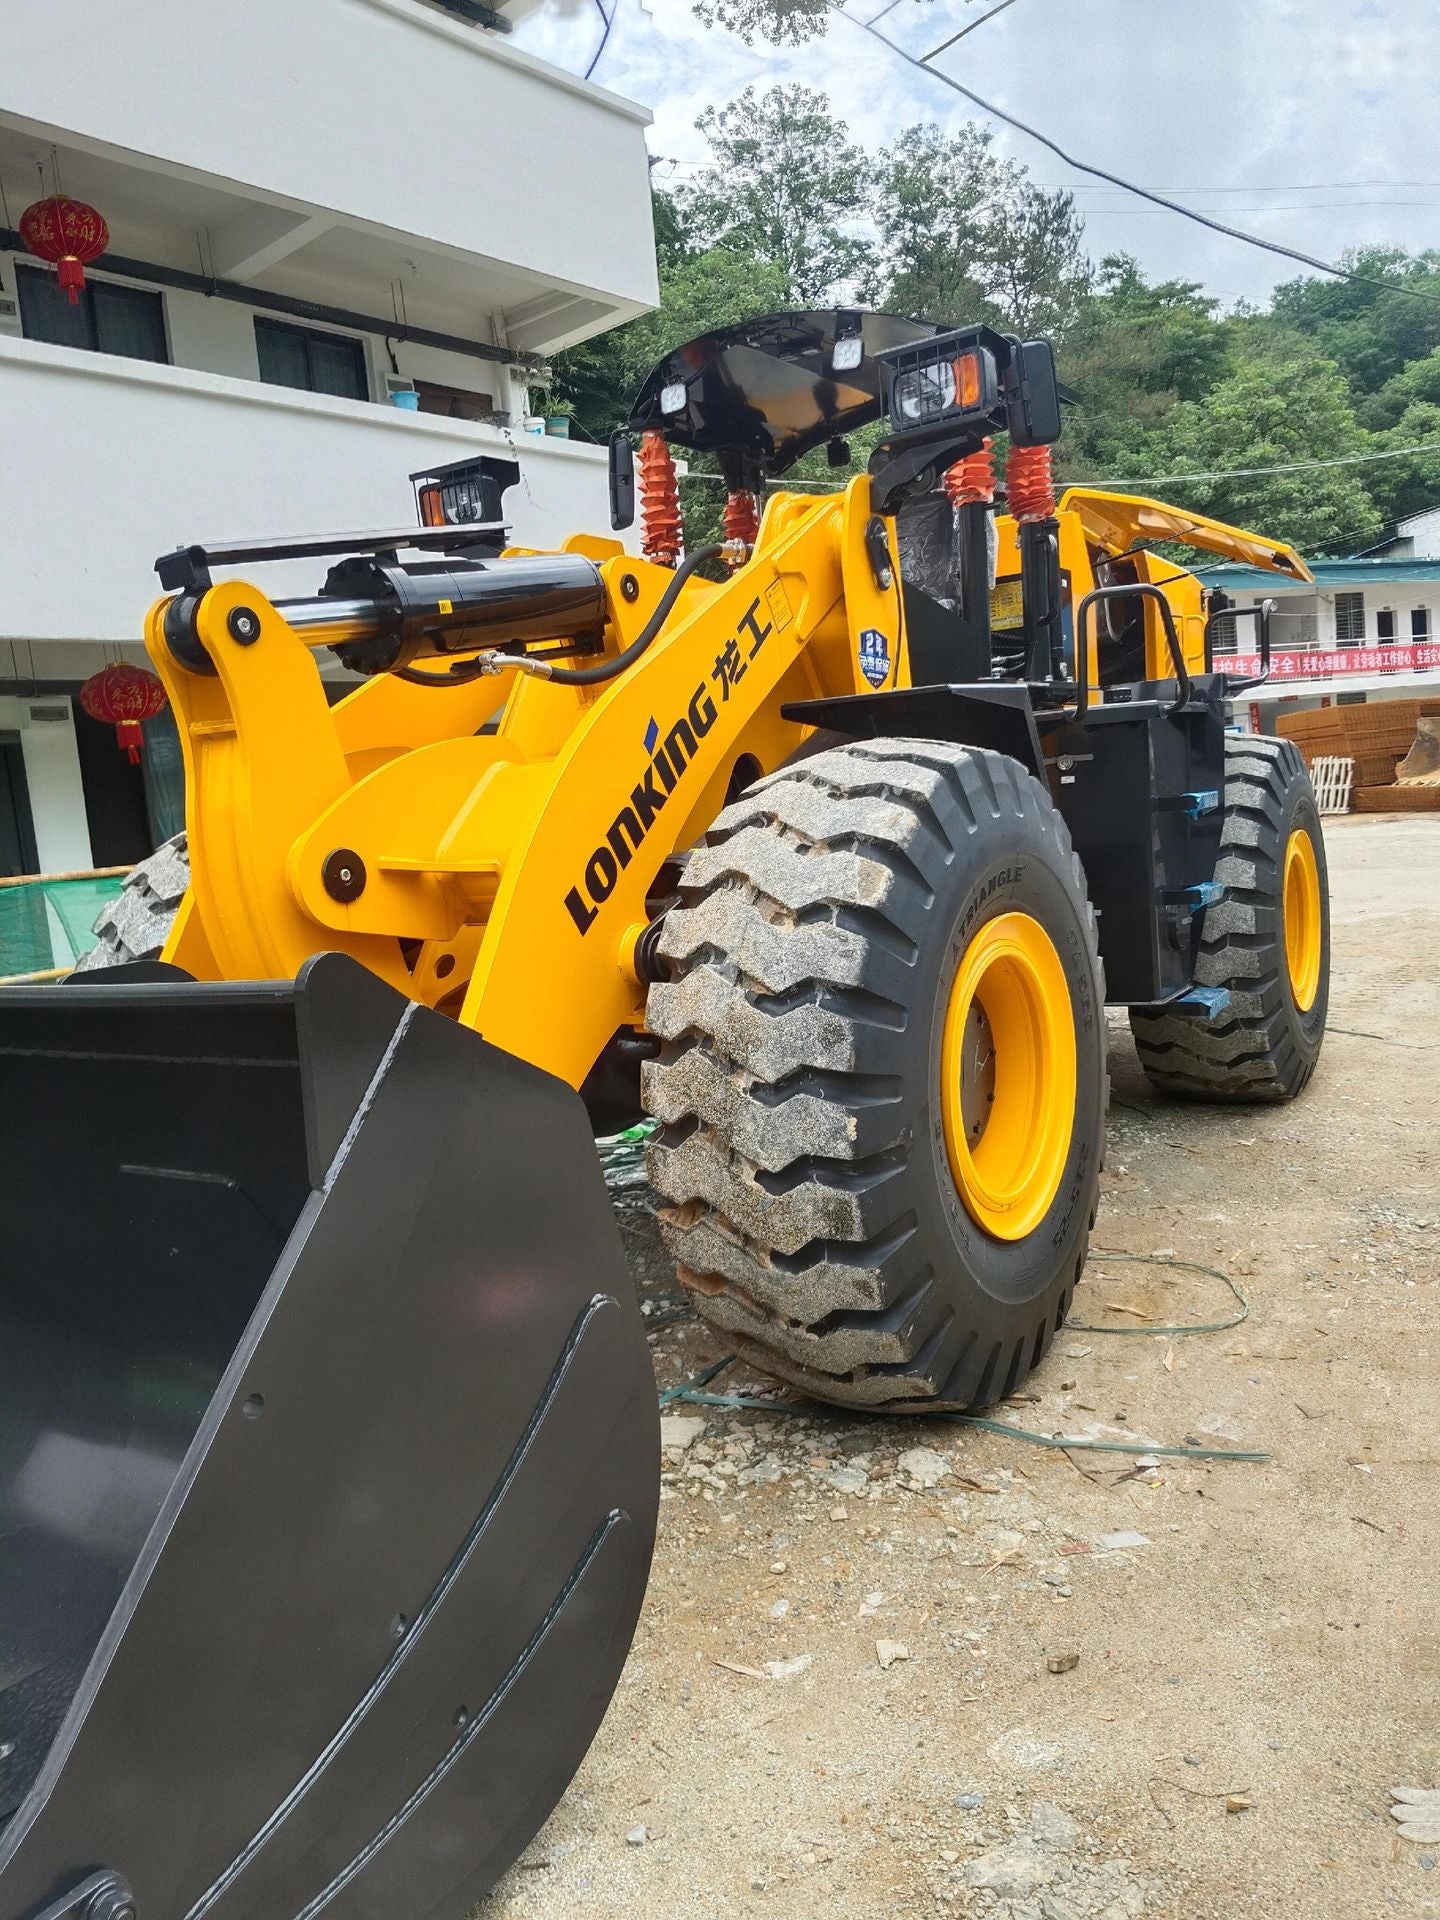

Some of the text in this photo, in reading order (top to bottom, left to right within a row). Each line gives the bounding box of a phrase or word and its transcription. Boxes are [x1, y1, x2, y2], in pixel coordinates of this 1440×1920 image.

[711, 595, 773, 702] 龙工
[563, 681, 719, 938] LONKING
[958, 865, 1023, 940] TRIANGLE
